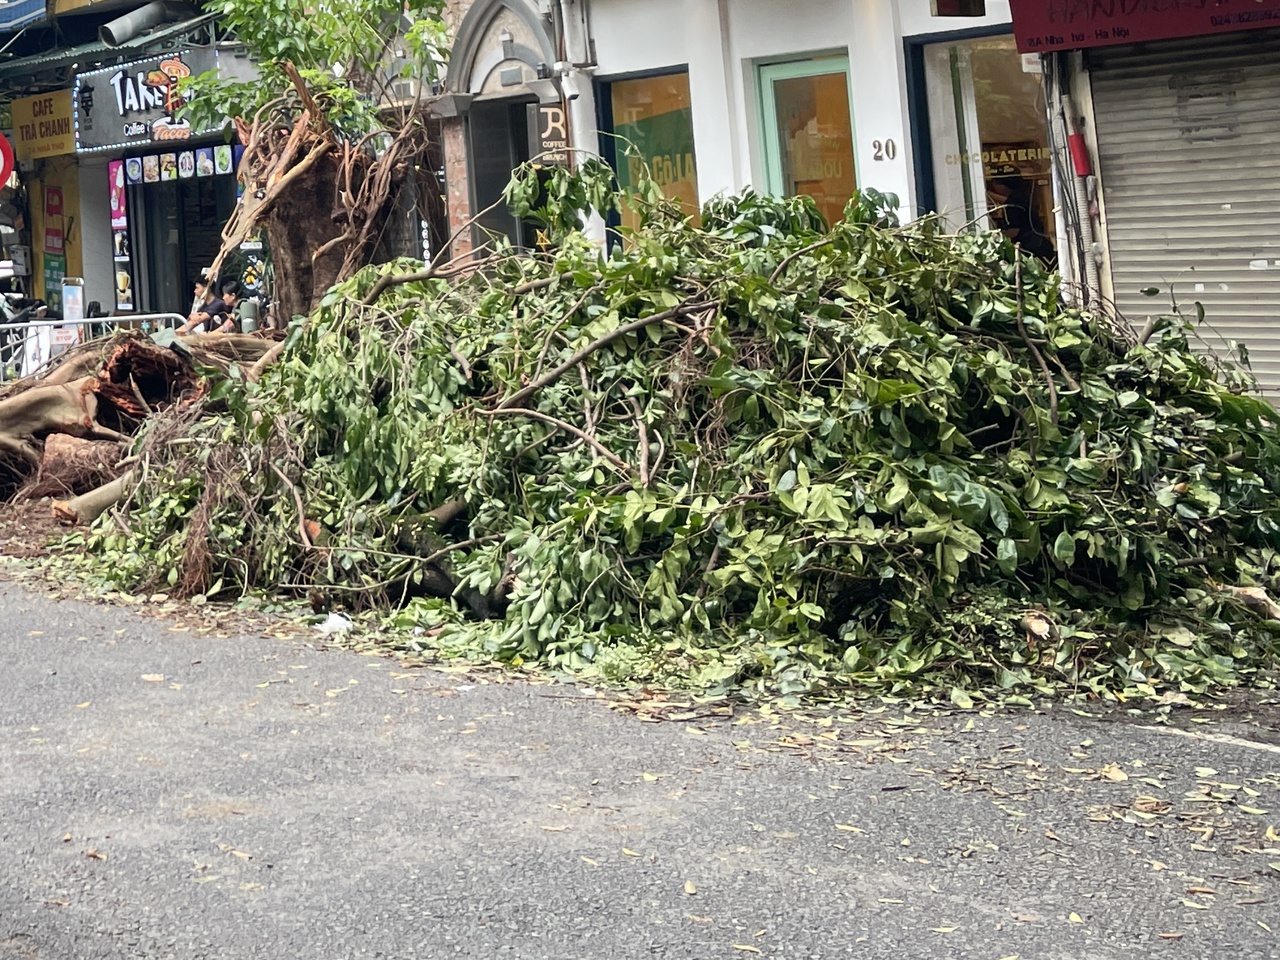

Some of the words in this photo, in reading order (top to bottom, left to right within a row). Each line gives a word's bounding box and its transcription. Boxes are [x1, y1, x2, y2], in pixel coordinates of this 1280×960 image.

[32, 97, 54, 118] CAFE
[39, 117, 71, 138] CHANH
[123, 120, 146, 137] Coffee
[152, 124, 191, 141] Tacos
[872, 138, 897, 161] 20
